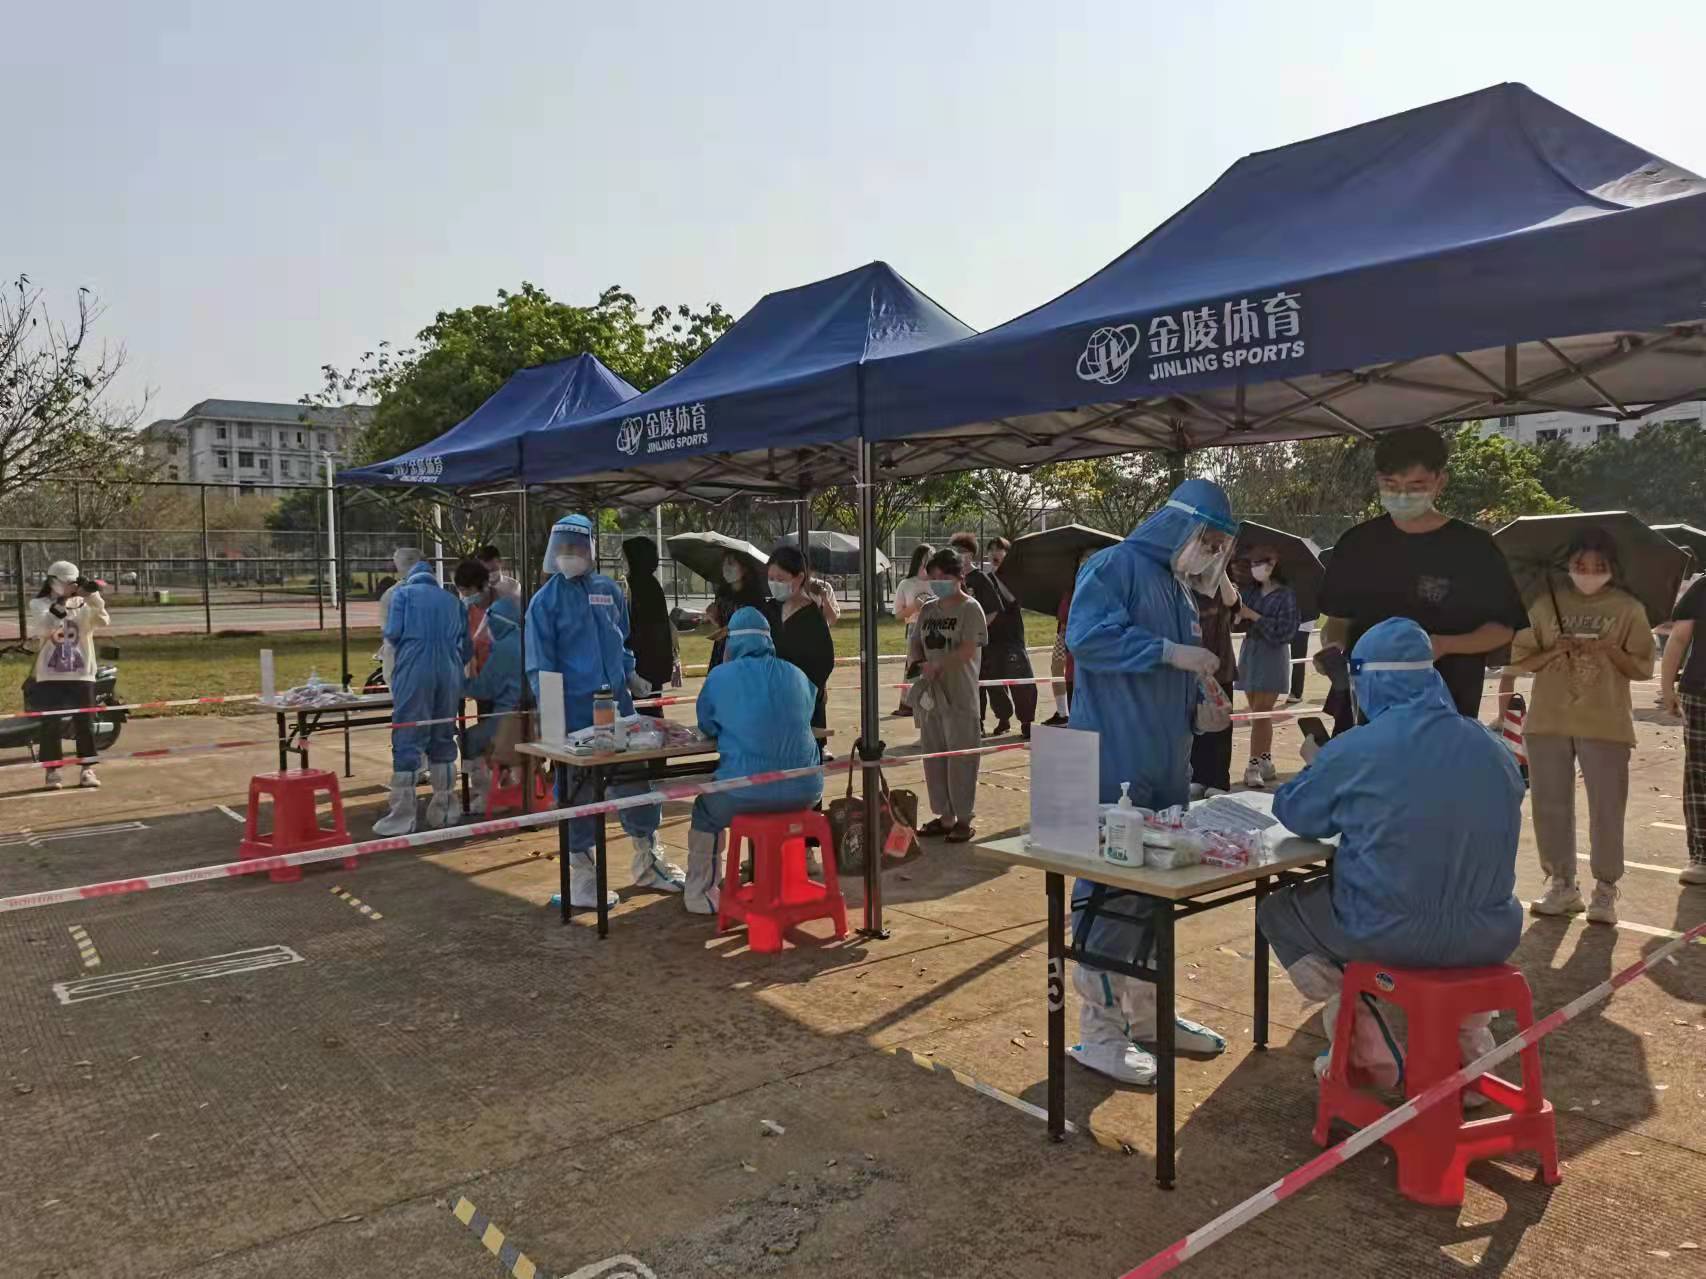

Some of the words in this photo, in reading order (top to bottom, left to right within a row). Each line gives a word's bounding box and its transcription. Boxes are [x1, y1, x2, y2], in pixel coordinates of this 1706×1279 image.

[1148, 292, 1302, 359] 金陵体育
[1149, 354, 1219, 380] JINLING
[1222, 340, 1305, 369] SPORTS
[646, 402, 706, 440] 金陵体育
[647, 438, 676, 453] JINLING
[676, 432, 708, 448] SPORTS
